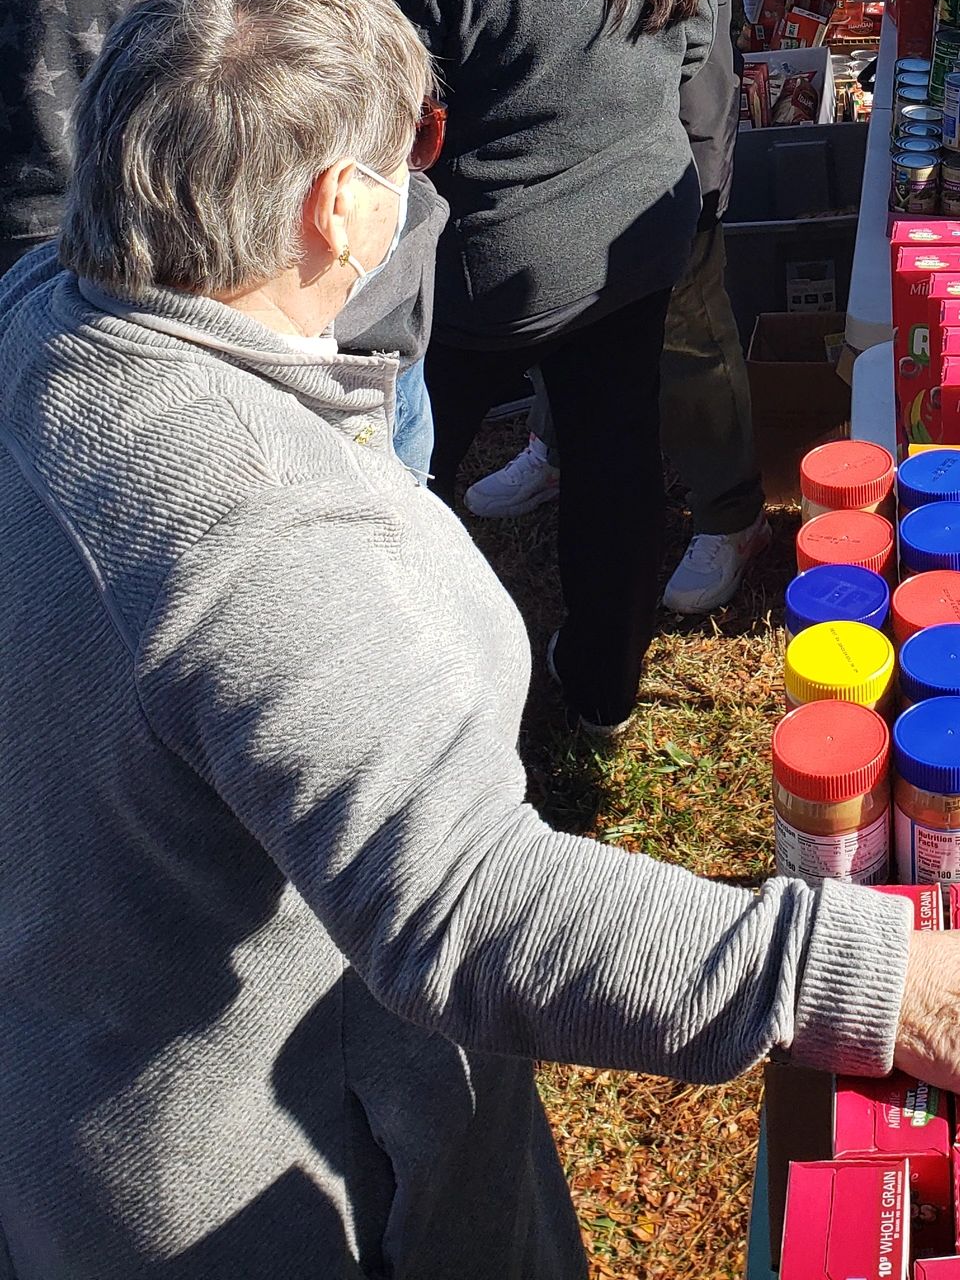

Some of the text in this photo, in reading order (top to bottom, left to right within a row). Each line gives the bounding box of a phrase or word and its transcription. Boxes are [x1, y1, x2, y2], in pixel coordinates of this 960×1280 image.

[918, 829, 952, 843] Nutrition
[918, 839, 938, 849] Facts
[937, 871, 951, 879] 180
[921, 891, 931, 918] GRAIN
[880, 1171, 896, 1254] WHOLE GRAIN
